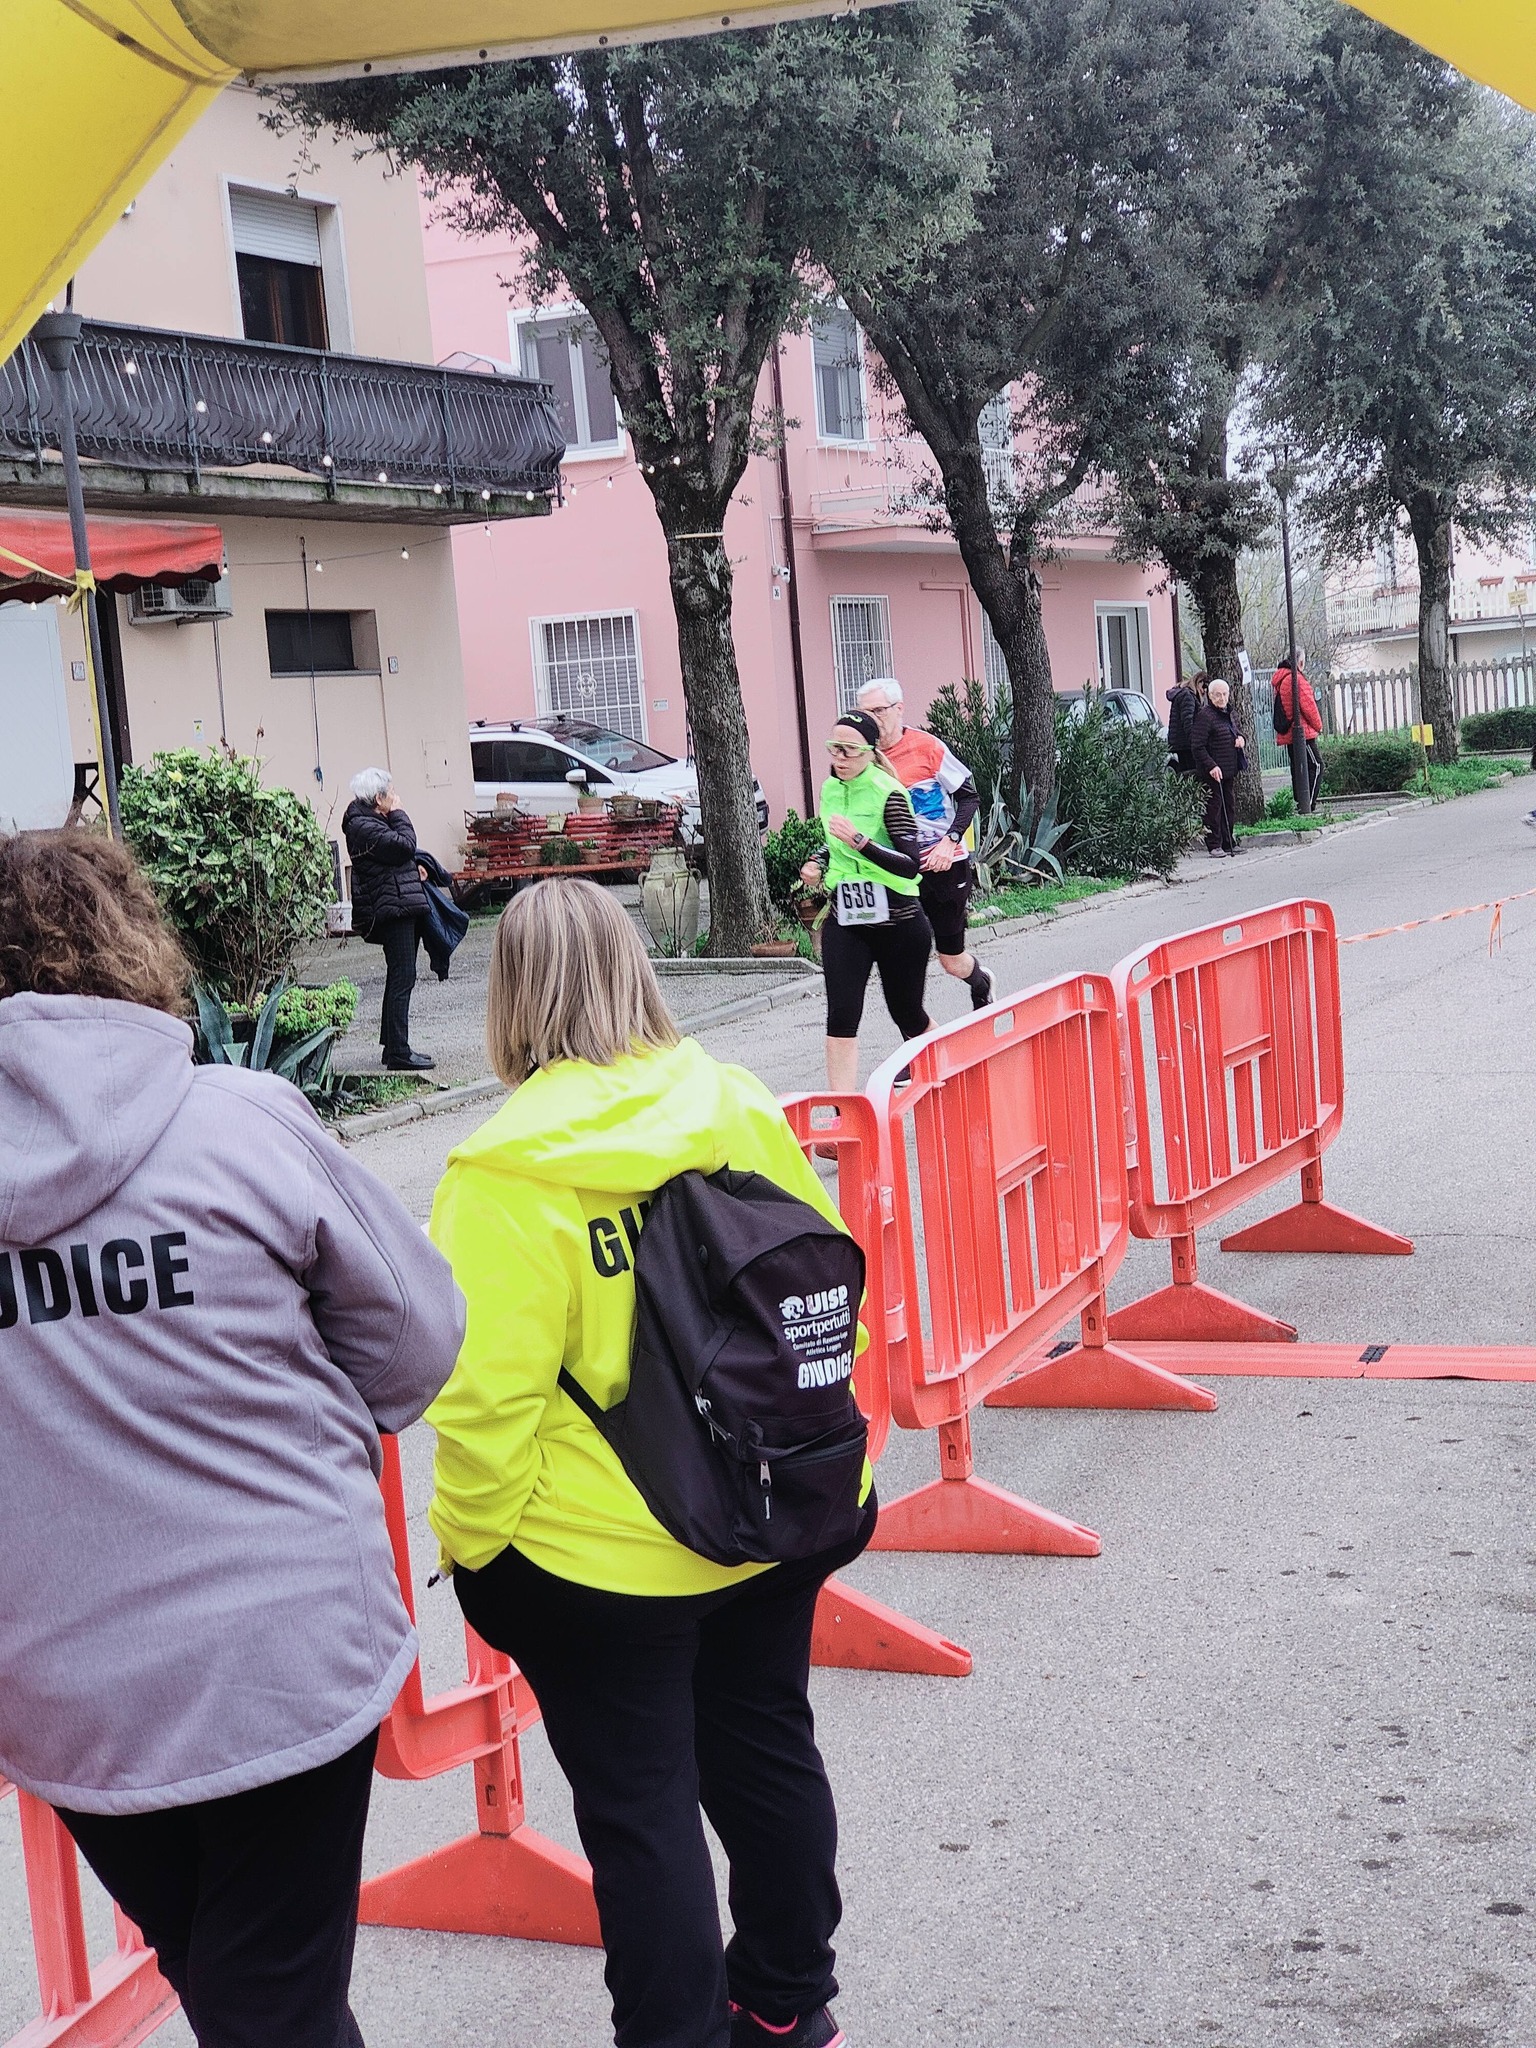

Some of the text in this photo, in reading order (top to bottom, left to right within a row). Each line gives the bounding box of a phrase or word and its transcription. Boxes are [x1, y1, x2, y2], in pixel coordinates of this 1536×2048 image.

[841, 881, 875, 909] 638
[588, 1200, 651, 1277] GI
[784, 1308, 851, 1343] sportpertutti
